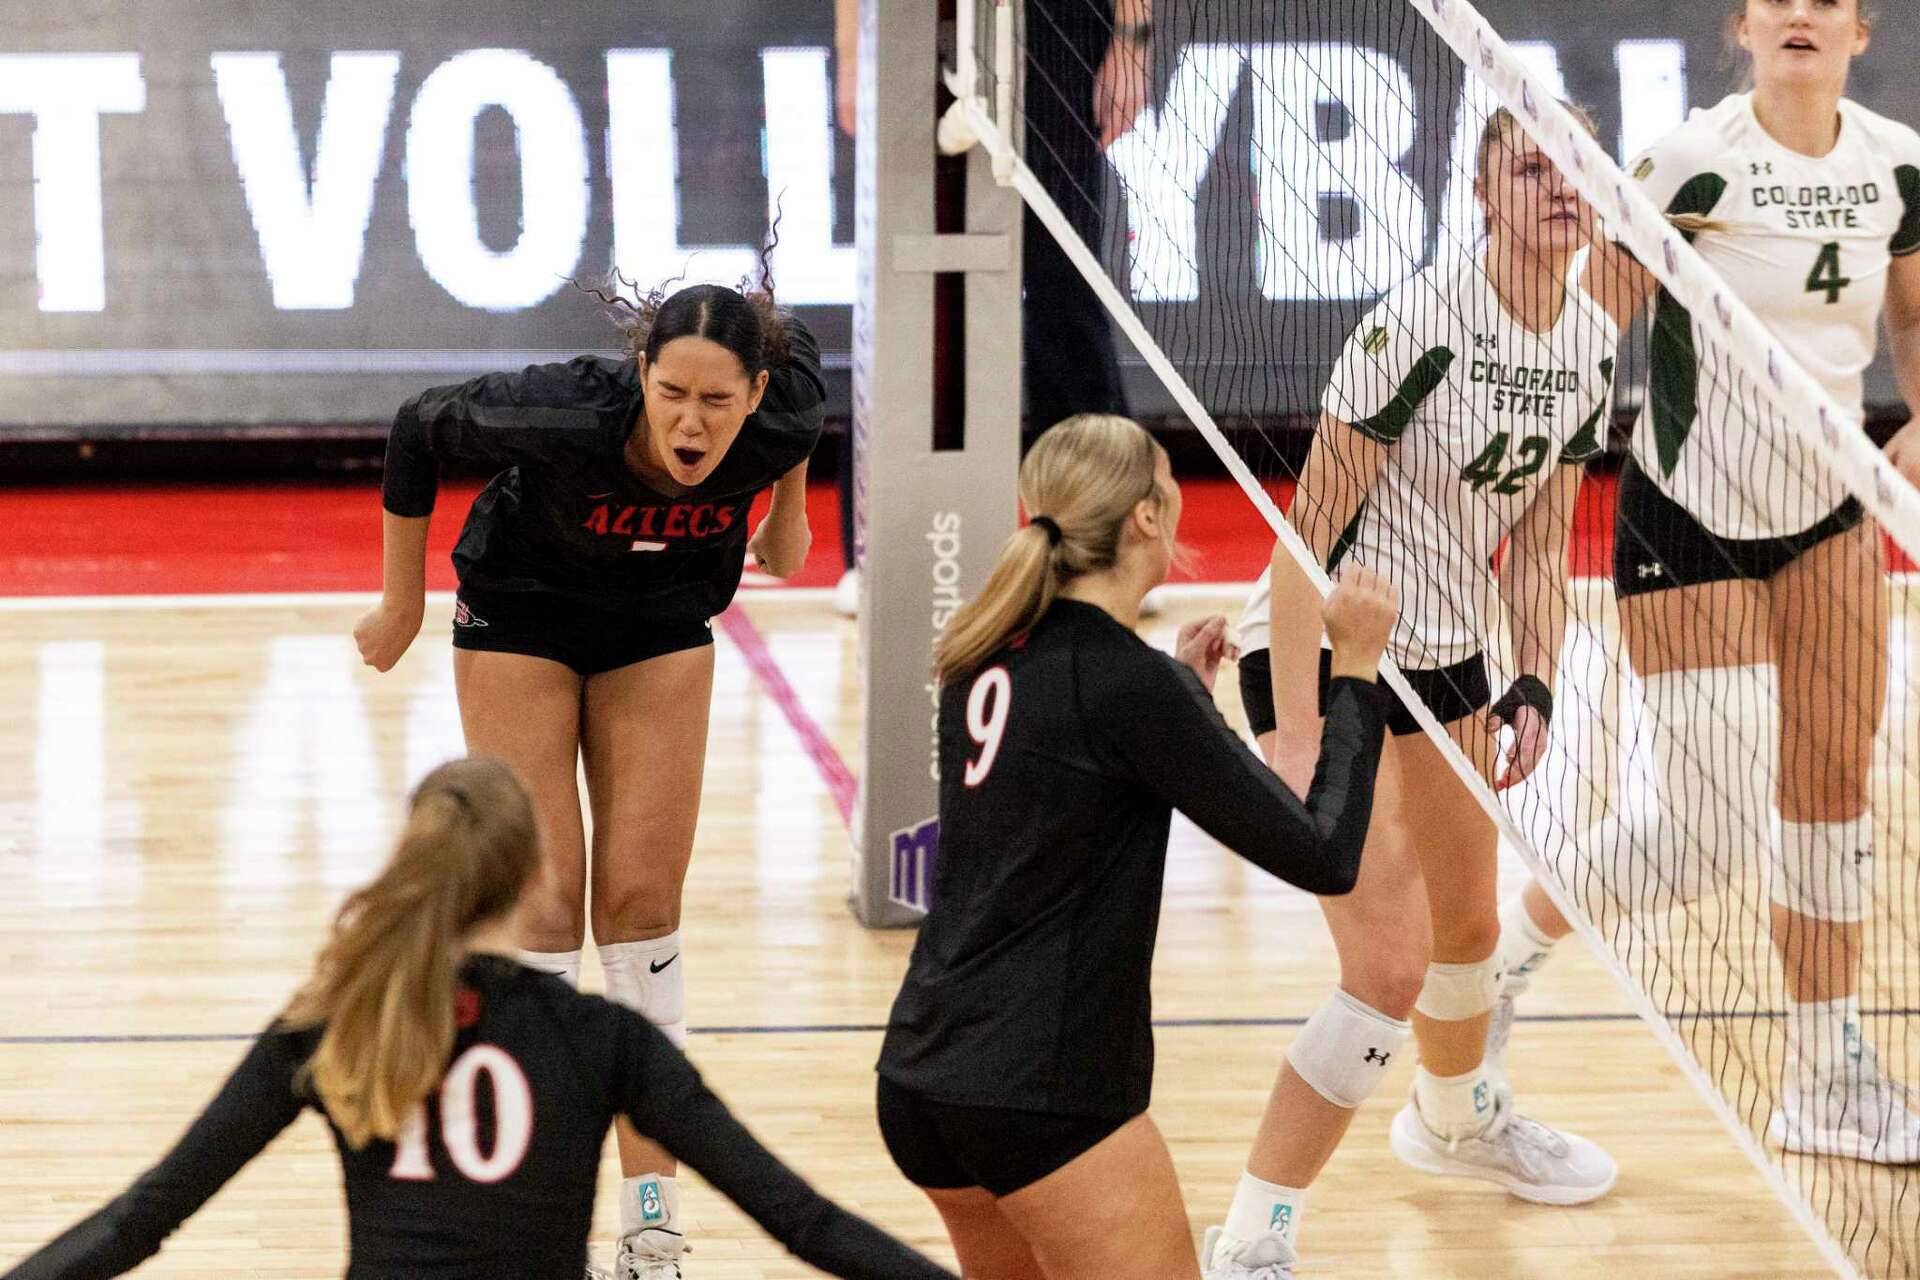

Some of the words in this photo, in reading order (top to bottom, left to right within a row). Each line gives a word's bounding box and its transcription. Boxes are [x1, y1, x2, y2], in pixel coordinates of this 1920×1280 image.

[1751, 181, 1880, 208] COLORADO
[1785, 208, 1858, 229] STATE
[1804, 241, 1851, 304] 4
[1470, 360, 1579, 393] COLORADO
[1493, 389, 1556, 417] STATE
[1463, 431, 1549, 495] 42
[583, 502, 735, 538] AZTECS
[963, 664, 1012, 787] 9
